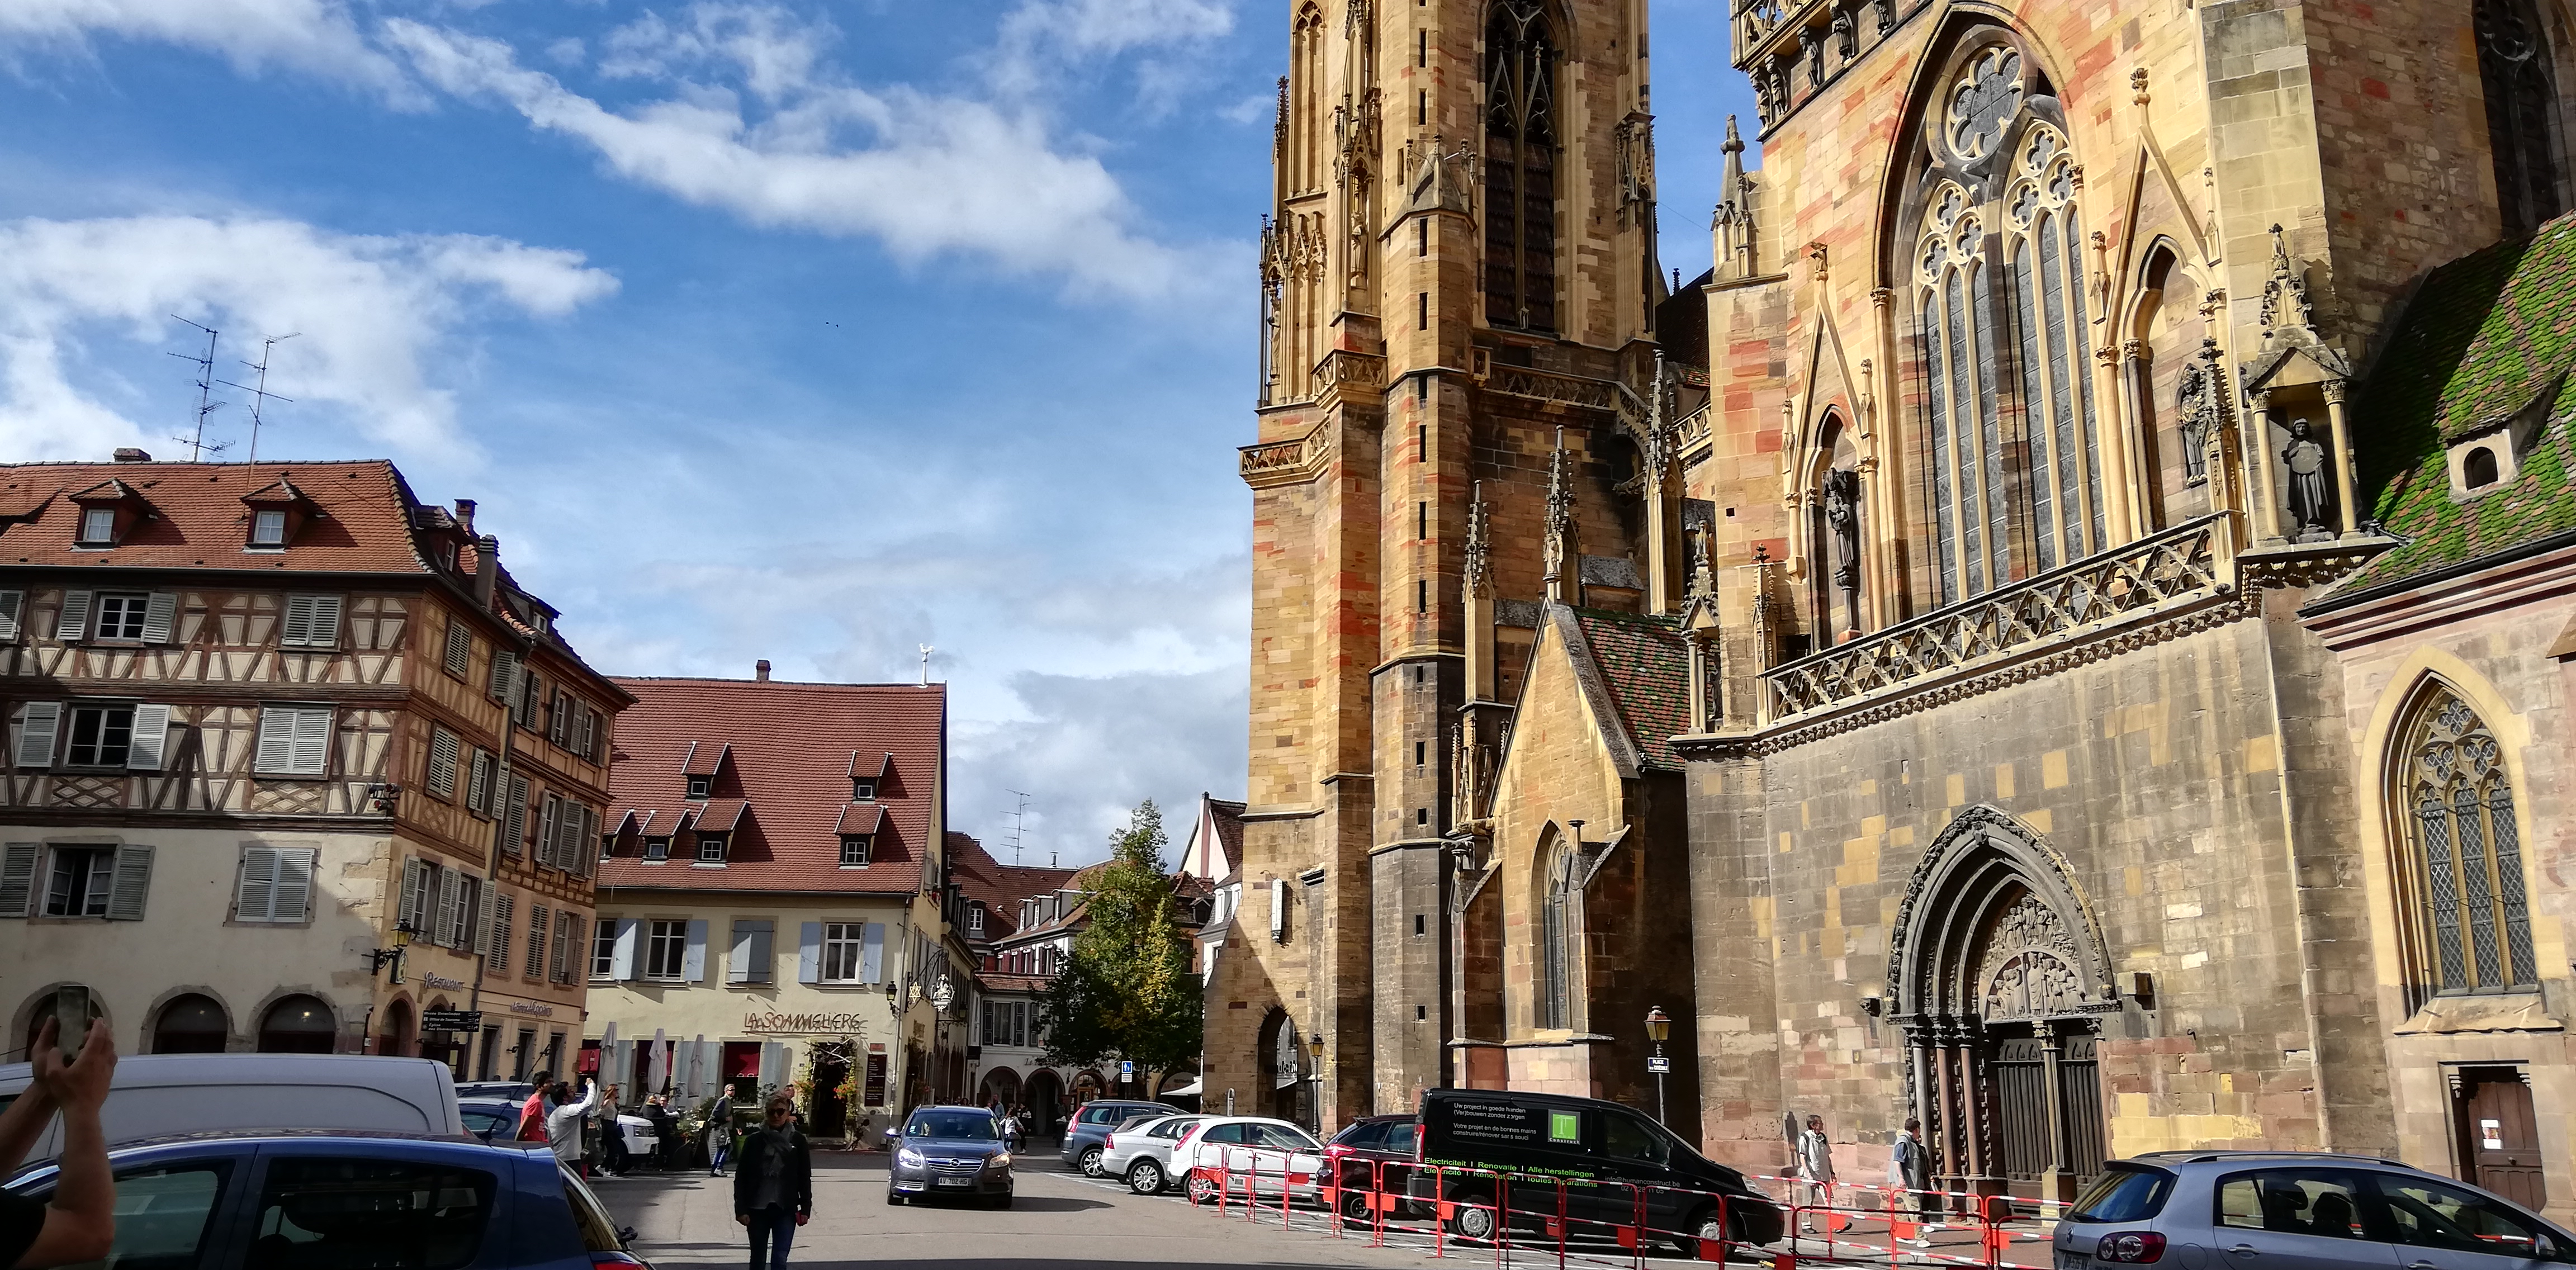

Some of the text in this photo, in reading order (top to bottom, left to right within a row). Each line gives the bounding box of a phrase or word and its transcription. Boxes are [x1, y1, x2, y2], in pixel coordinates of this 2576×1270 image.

[744, 1012, 757, 1028] LA
[1424, 1157, 1466, 1167] Electriciteit
[1478, 1162, 1517, 1171] Renovatie
[1545, 1168, 1594, 1178] herstellingen
